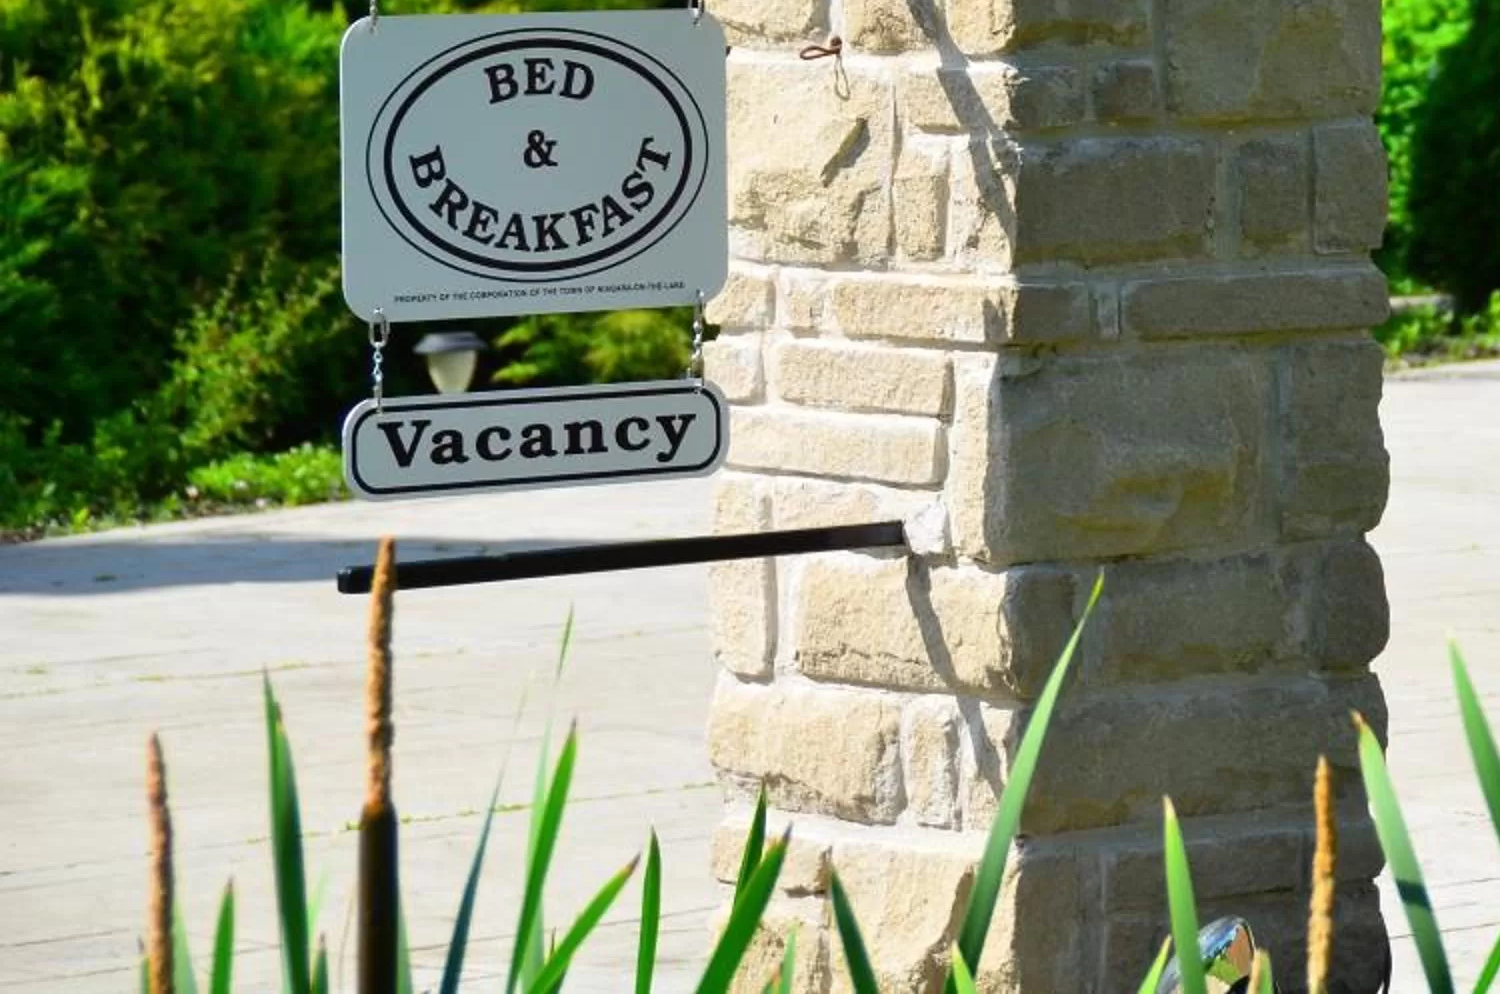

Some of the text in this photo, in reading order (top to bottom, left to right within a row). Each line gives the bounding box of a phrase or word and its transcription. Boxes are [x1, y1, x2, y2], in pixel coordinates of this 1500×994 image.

[484, 57, 595, 104] BED
[523, 129, 558, 168] &
[409, 137, 672, 252] BREAKFAST
[394, 292, 437, 303] PROPERTY
[439, 292, 449, 302] OF
[453, 291, 467, 301] THE
[470, 288, 526, 299] CORPORATION
[530, 287, 540, 297] OF
[542, 287, 557, 296] THE
[560, 286, 583, 295] TOWN
[584, 285, 595, 294] OF
[377, 413, 697, 468] Vacancy
